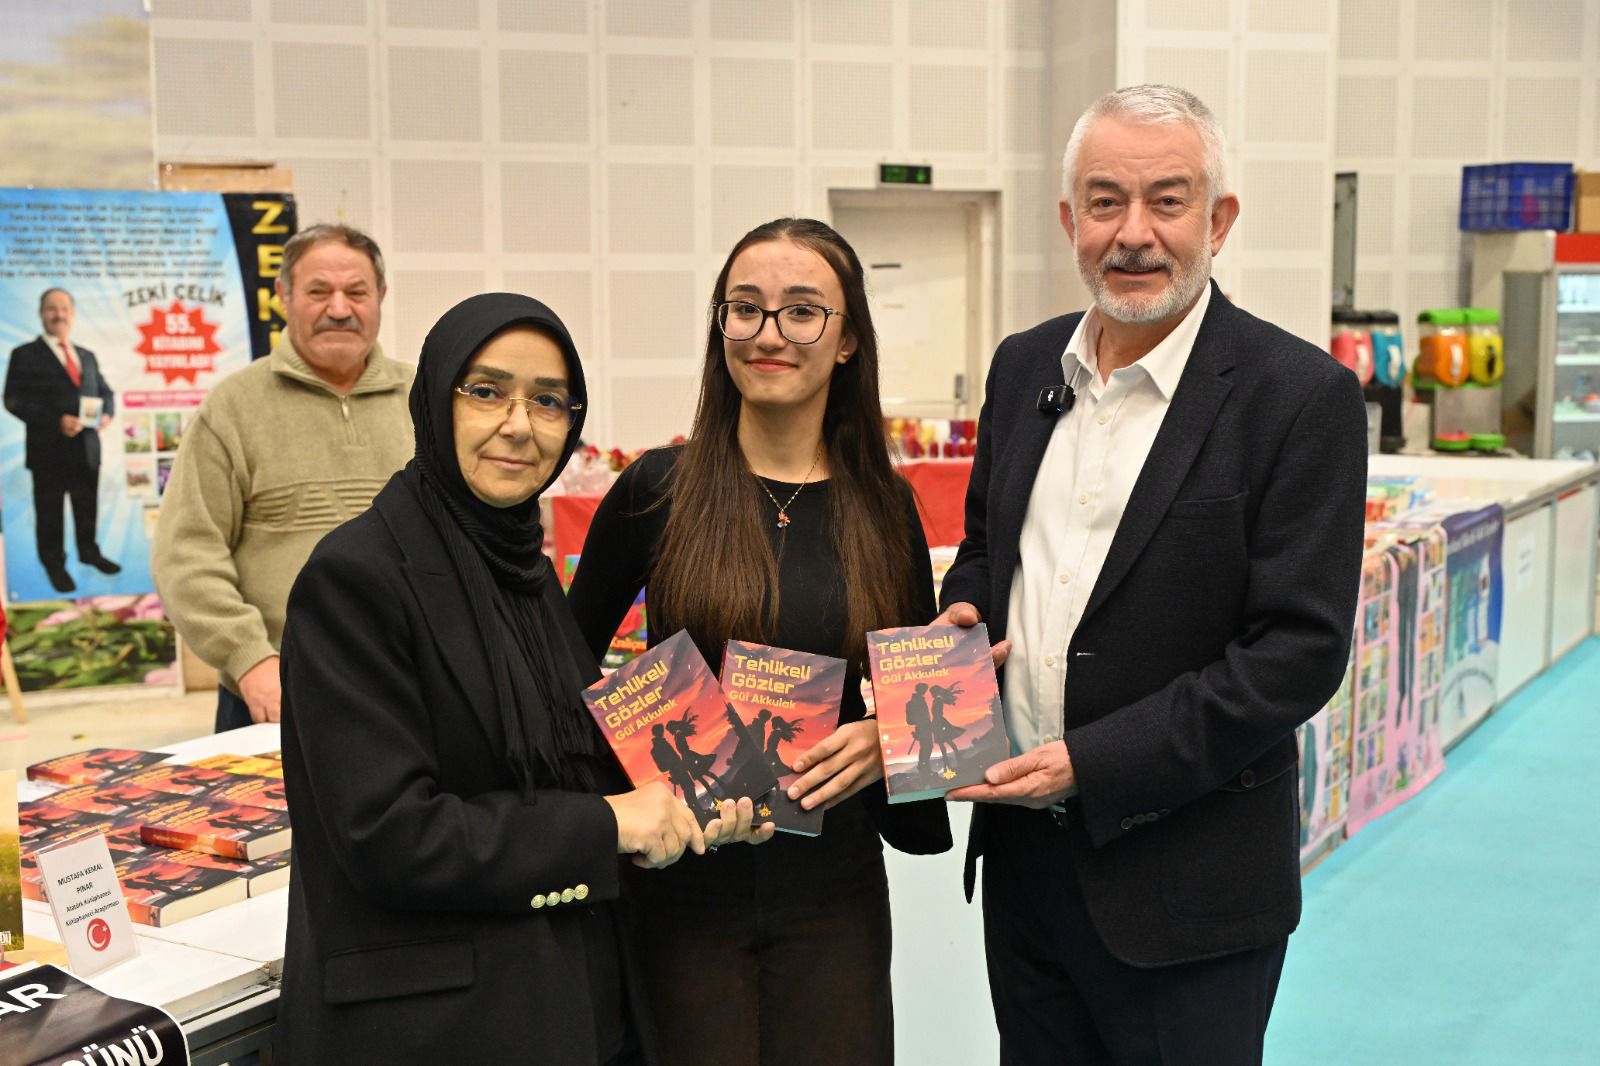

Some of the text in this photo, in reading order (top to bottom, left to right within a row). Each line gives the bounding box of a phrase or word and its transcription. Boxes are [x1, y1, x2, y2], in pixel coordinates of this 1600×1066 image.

[876, 635, 955, 655] Tehlikeli
[734, 654, 812, 681] Tehlikeli
[879, 653, 943, 672] Gözler
[594, 660, 669, 711] Tehlikeli
[731, 672, 795, 694] Gözler
[881, 667, 951, 685] Gül Akkulak
[605, 686, 663, 729] Gözler
[729, 690, 796, 710] Gül Akkulak
[615, 699, 678, 741] Gül Akkulak
[57, 863, 104, 886] MUSTAFA KEMAL
[76, 881, 94, 894] PINAR
[61, 1025, 164, 1066] ÜNÜ
